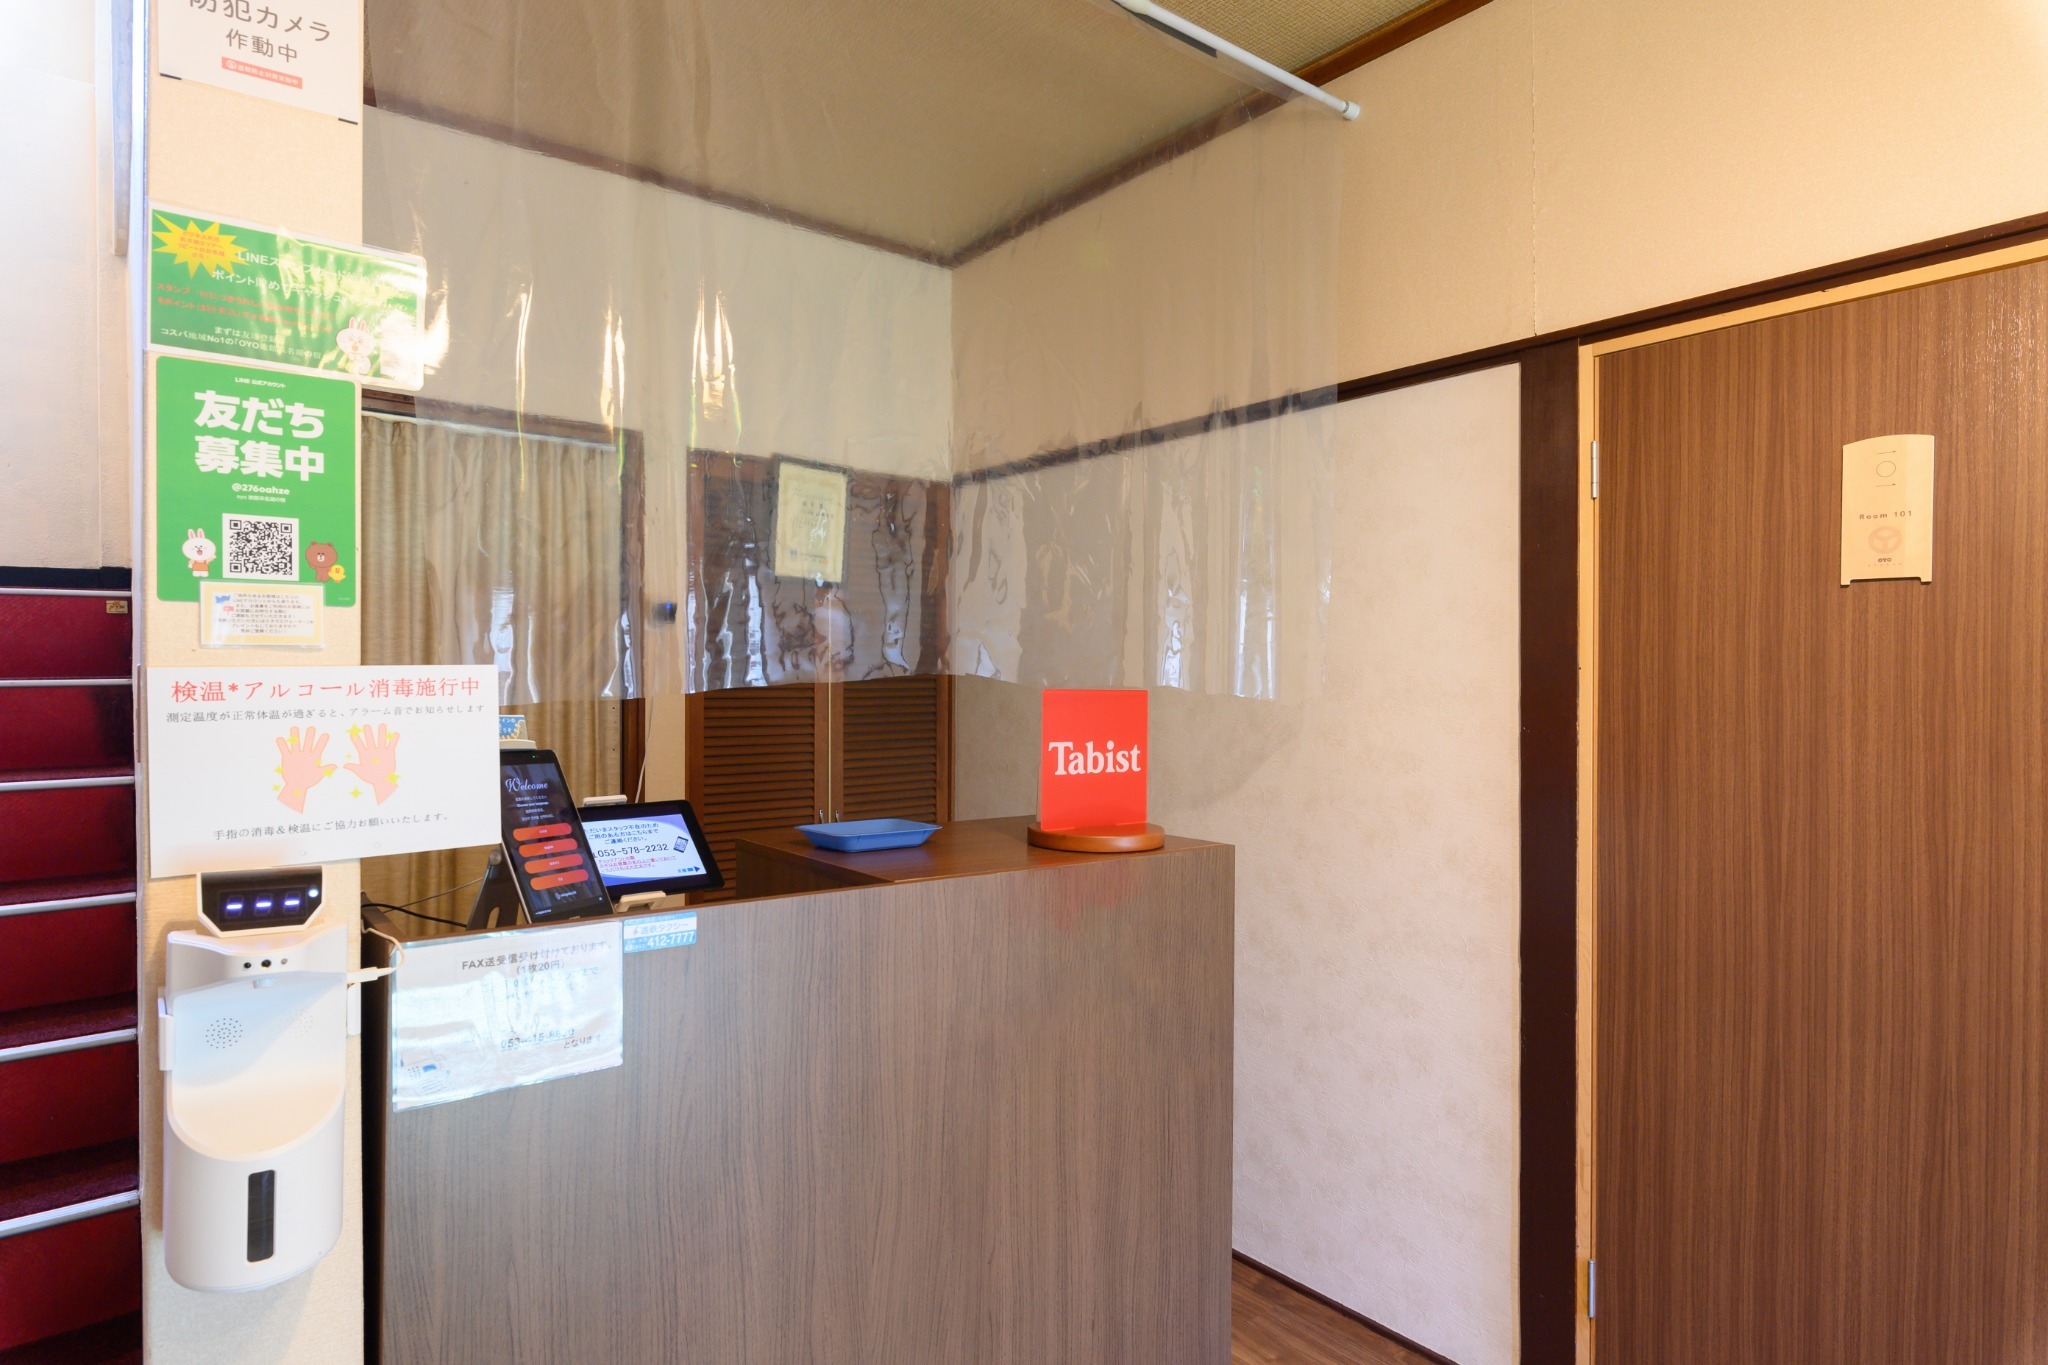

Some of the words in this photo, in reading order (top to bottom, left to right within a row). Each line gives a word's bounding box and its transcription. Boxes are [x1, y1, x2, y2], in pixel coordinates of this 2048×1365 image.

[226, 28, 297, 62] 作動中
[194, 390, 325, 439] 友だち
[194, 435, 325, 482] 募集中
[1894, 510, 1913, 518] 101
[166, 705, 485, 723] 測定温度が正常体温が過ぎると、アラーム音でお知らせします
[1048, 740, 1142, 776] Tabist
[505, 777, 549, 793] Welcome
[648, 931, 695, 947] 412-7777
